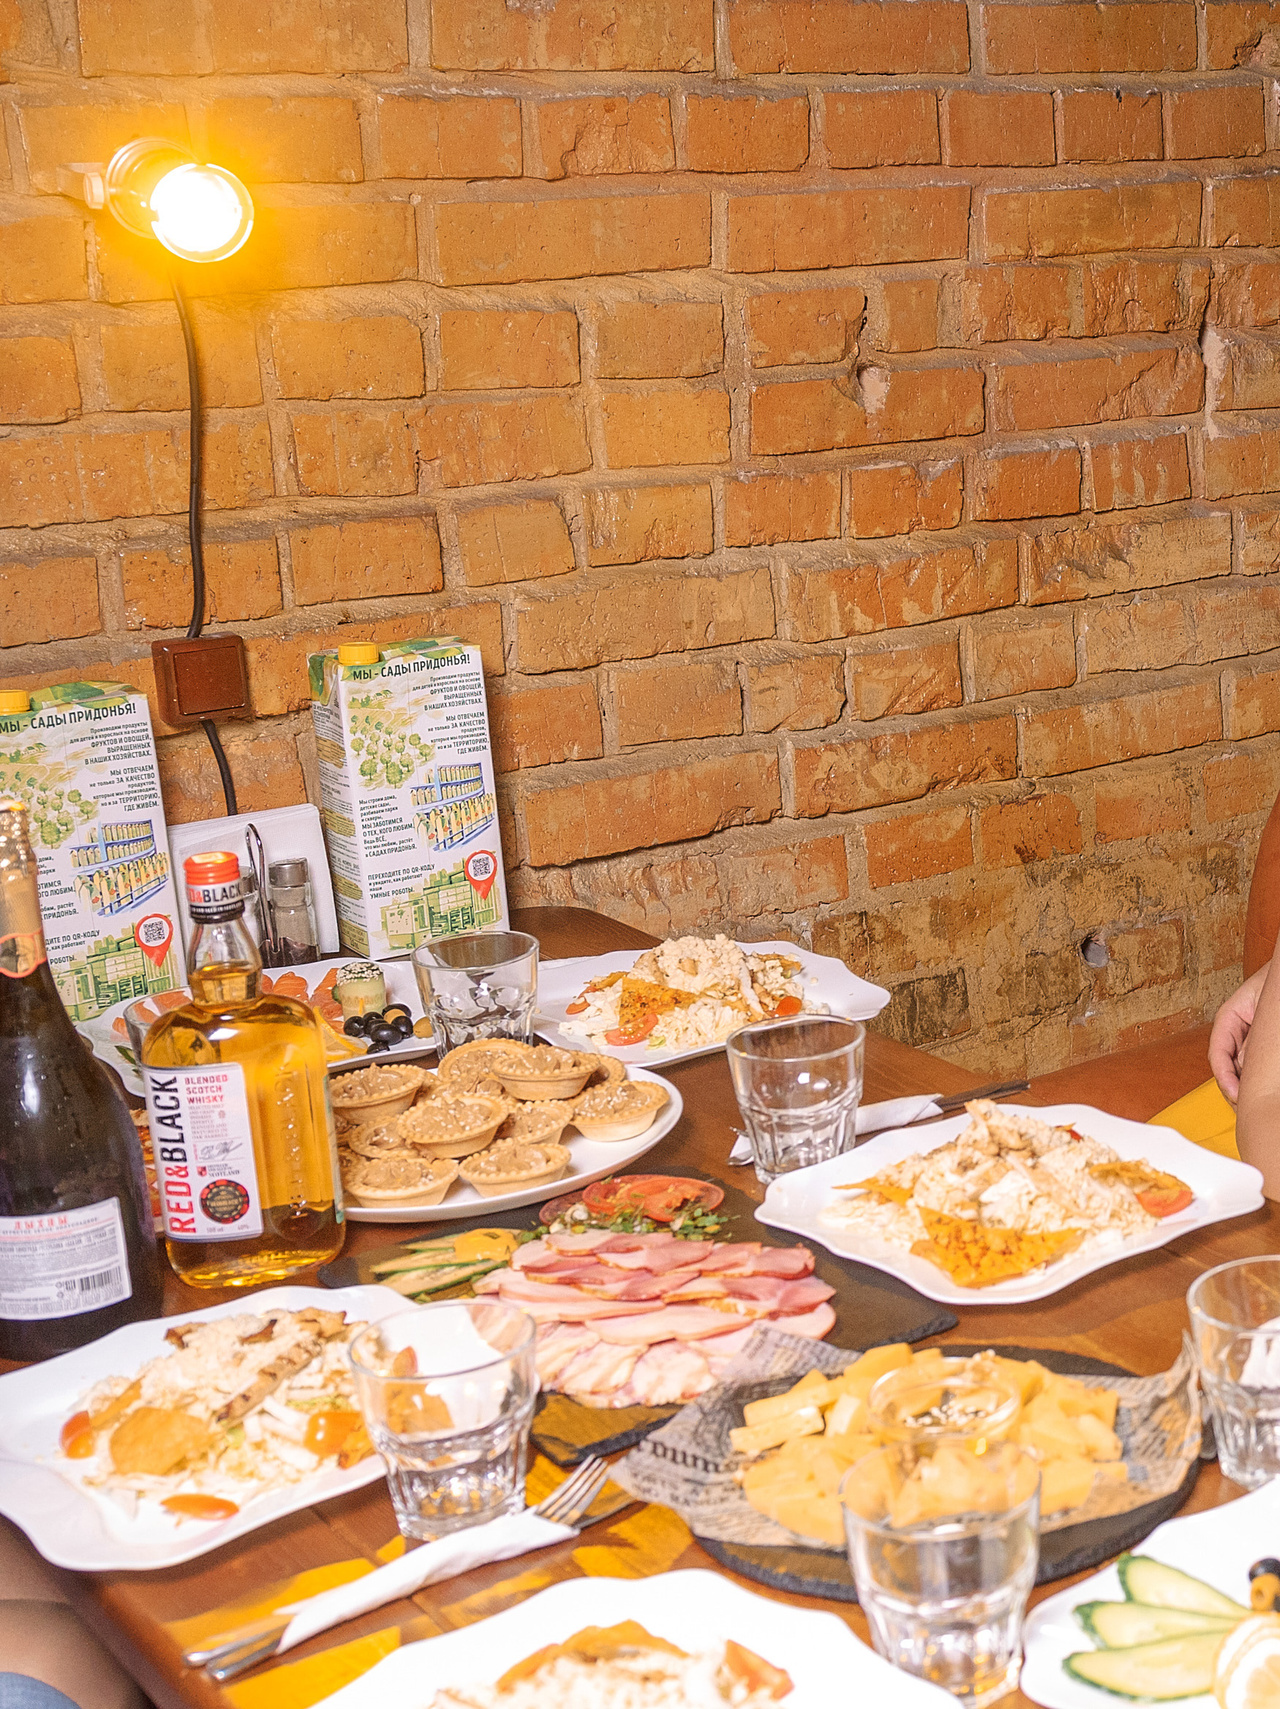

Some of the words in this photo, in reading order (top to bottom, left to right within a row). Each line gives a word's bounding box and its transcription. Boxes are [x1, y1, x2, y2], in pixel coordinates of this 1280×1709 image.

[353, 669, 372, 681] МЫ
[381, 663, 411, 678] САДЫ
[413, 654, 470, 673] ПРИДОНЬЯ!
[0, 720, 20, 734] МЫ
[31, 714, 66, 731] САДЫ
[70, 703, 136, 724] ПРИДОНЬЯ!
[457, 711, 484, 720] ОТВЕЧАЕМ
[91, 738, 118, 748] ФРУКТОВ
[124, 733, 152, 744] ОВОЩЕЙ,
[107, 742, 150, 754] ВЫРАЩЕННЫХ
[91, 755, 111, 764] НАШИХ
[113, 749, 152, 761] ХОЗЯЙСТВАХ.
[123, 764, 154, 775] ОТВЕЧАЕМ
[124, 804, 134, 812] ГДЕ
[136, 800, 159, 810] ЖИВЁМ.
[368, 870, 401, 881] ПЕРЕХОДИТЕ
[411, 864, 435, 873] QR-КОДУ
[38, 880, 61, 890] ОТИМСЯ
[187, 882, 241, 903] D&BLACK
[44, 908, 79, 920] ПРИДОНЬЯ.
[73, 929, 100, 940] QR-КОДУ
[50, 954, 77, 965] РОБОТЫ.
[184, 1074, 228, 1085] BLENDED
[186, 1085, 222, 1095] SCOTCH
[187, 1095, 224, 1105] WHISKY
[150, 1076, 196, 1233] RED&BLACK
